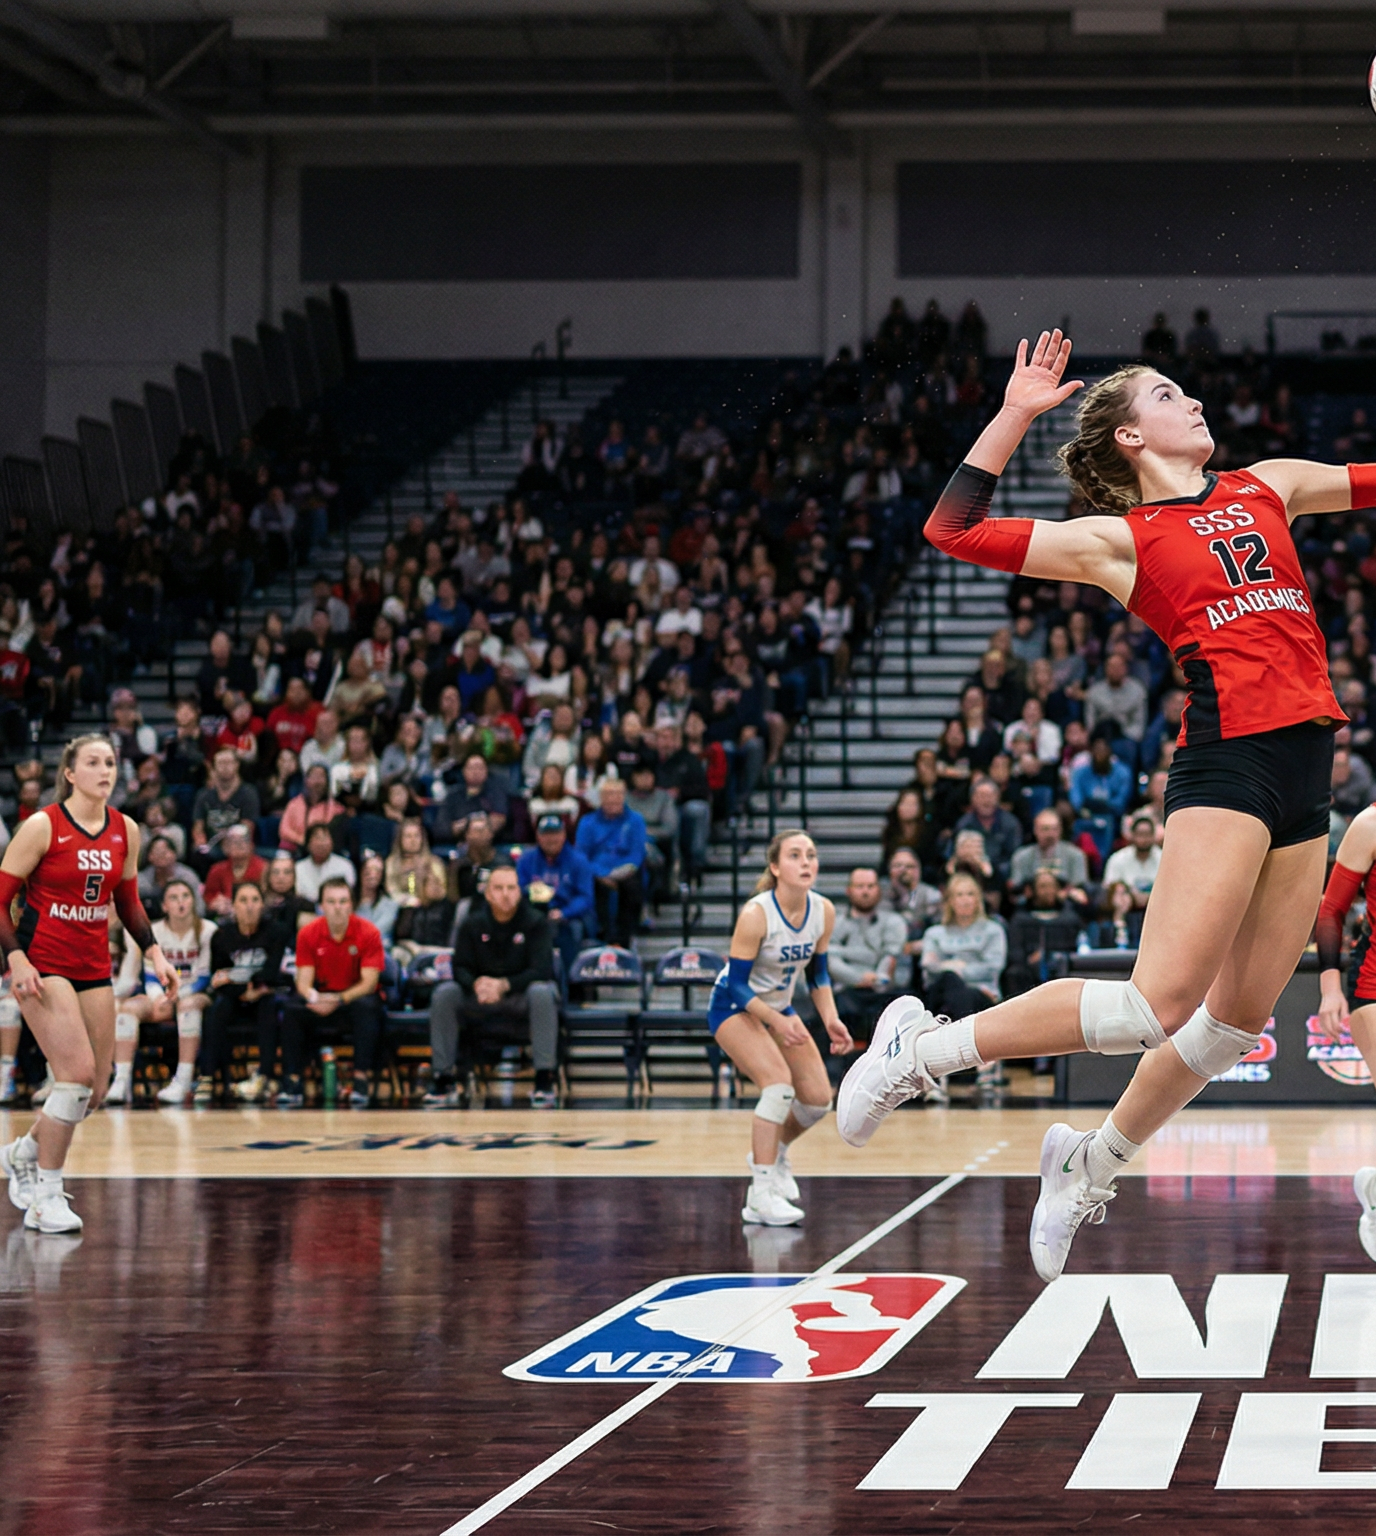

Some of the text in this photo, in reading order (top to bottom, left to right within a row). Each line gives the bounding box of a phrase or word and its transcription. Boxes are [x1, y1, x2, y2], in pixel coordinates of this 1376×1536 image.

[1187, 503, 1256, 537] SSS
[1208, 530, 1276, 589] 12
[1205, 587, 1311, 631] ACADEMIES
[77, 849, 113, 872] SSS
[83, 873, 105, 904] 5
[564, 1351, 738, 1374] NBA
